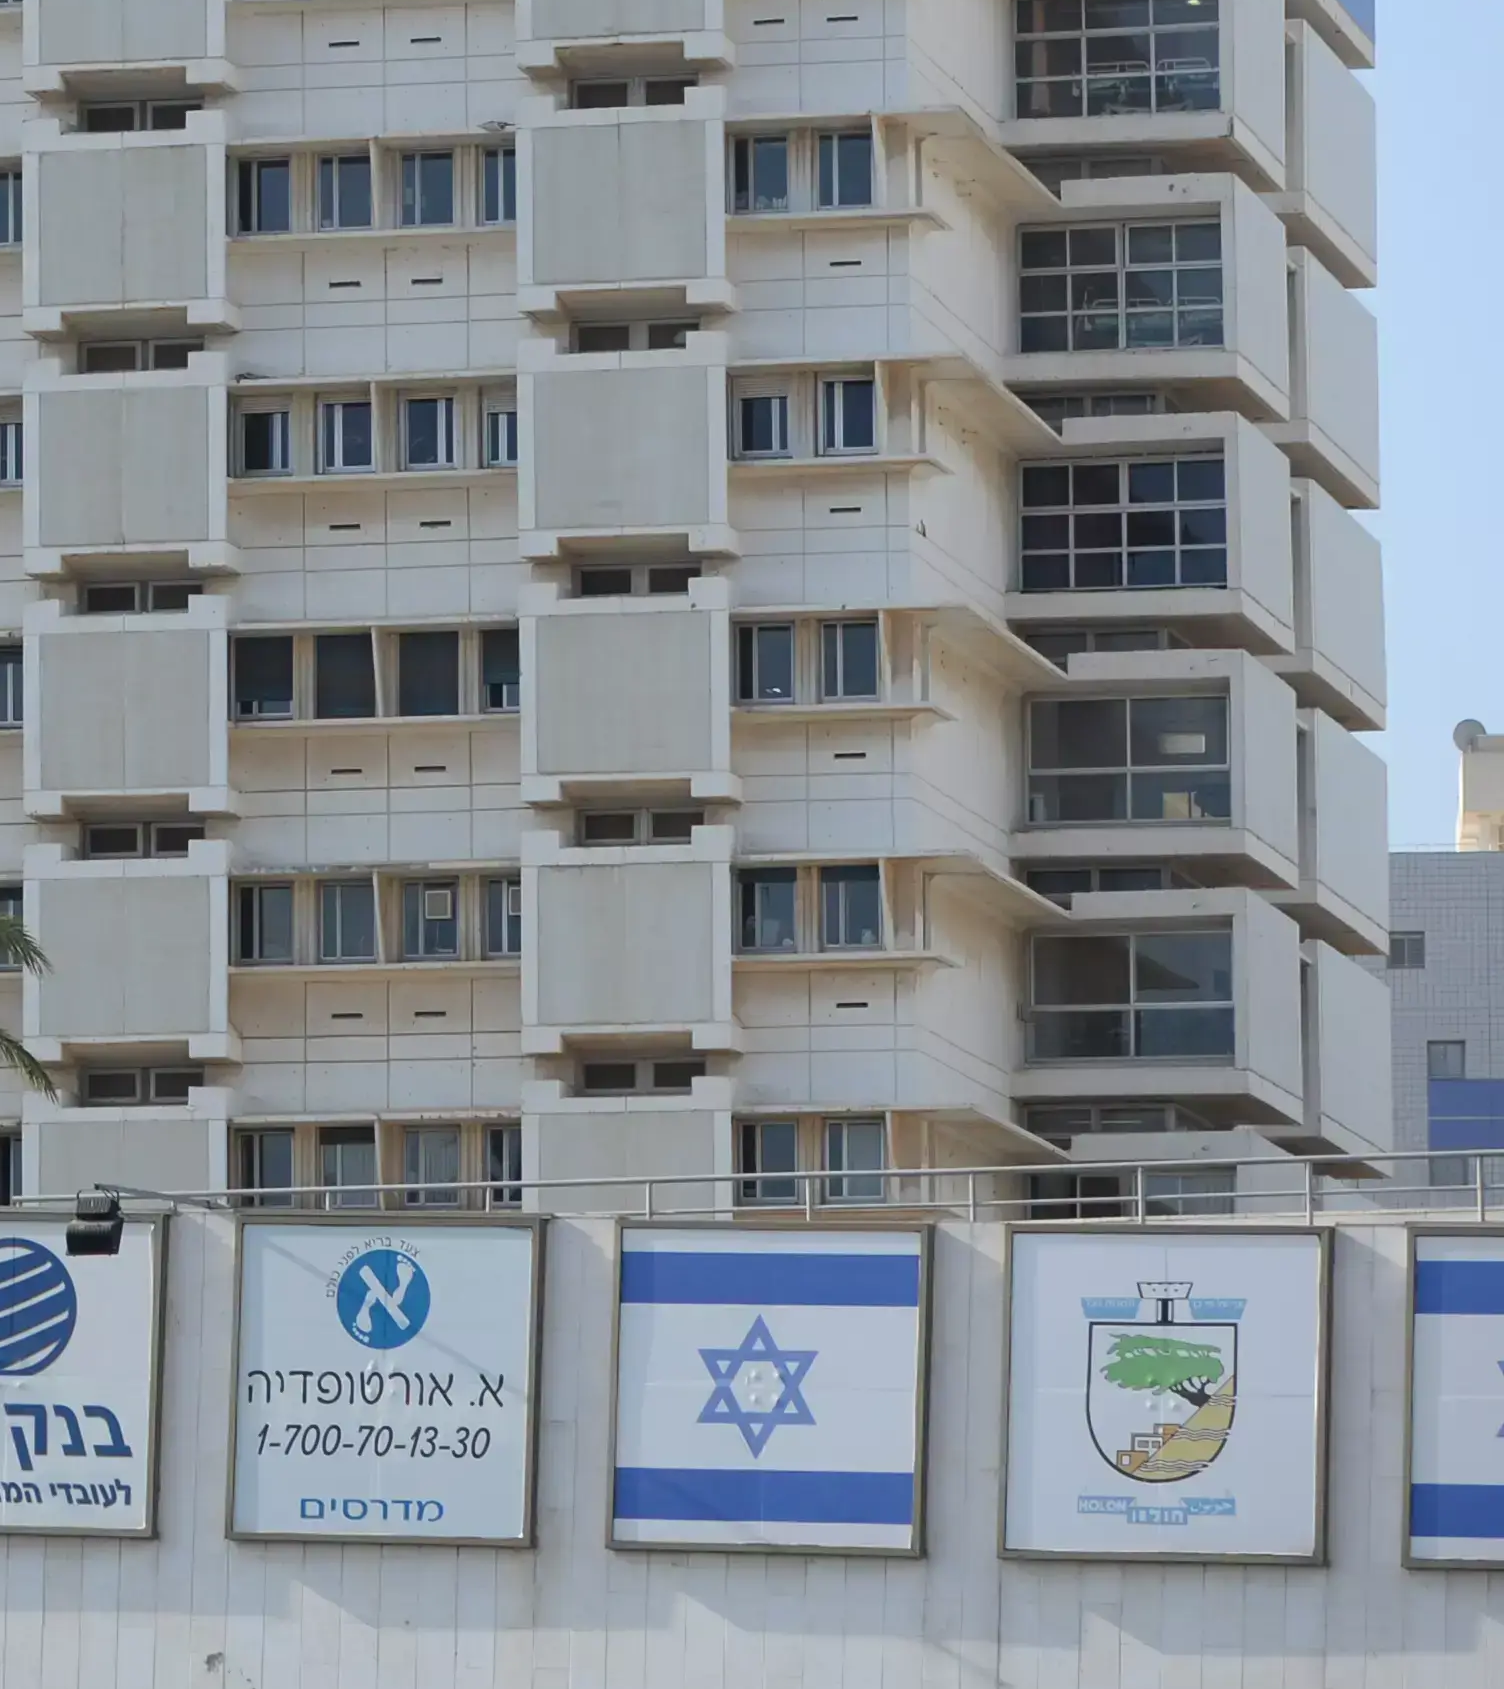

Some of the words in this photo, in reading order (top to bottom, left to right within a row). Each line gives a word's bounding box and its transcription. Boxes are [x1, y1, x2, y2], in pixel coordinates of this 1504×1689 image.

[338, 1245, 360, 1267] לפני
[364, 1237, 392, 1250] בריא
[248, 1369, 454, 1408] אורטופדיה
[469, 1376, 505, 1409] א.
[4, 1403, 133, 1471] בנק
[256, 1423, 491, 1460] 1-700-70-13-30
[49, 1479, 133, 1508] לעובדי
[1078, 1498, 1127, 1513] HOLON
[300, 1496, 444, 1523] מדרסים
